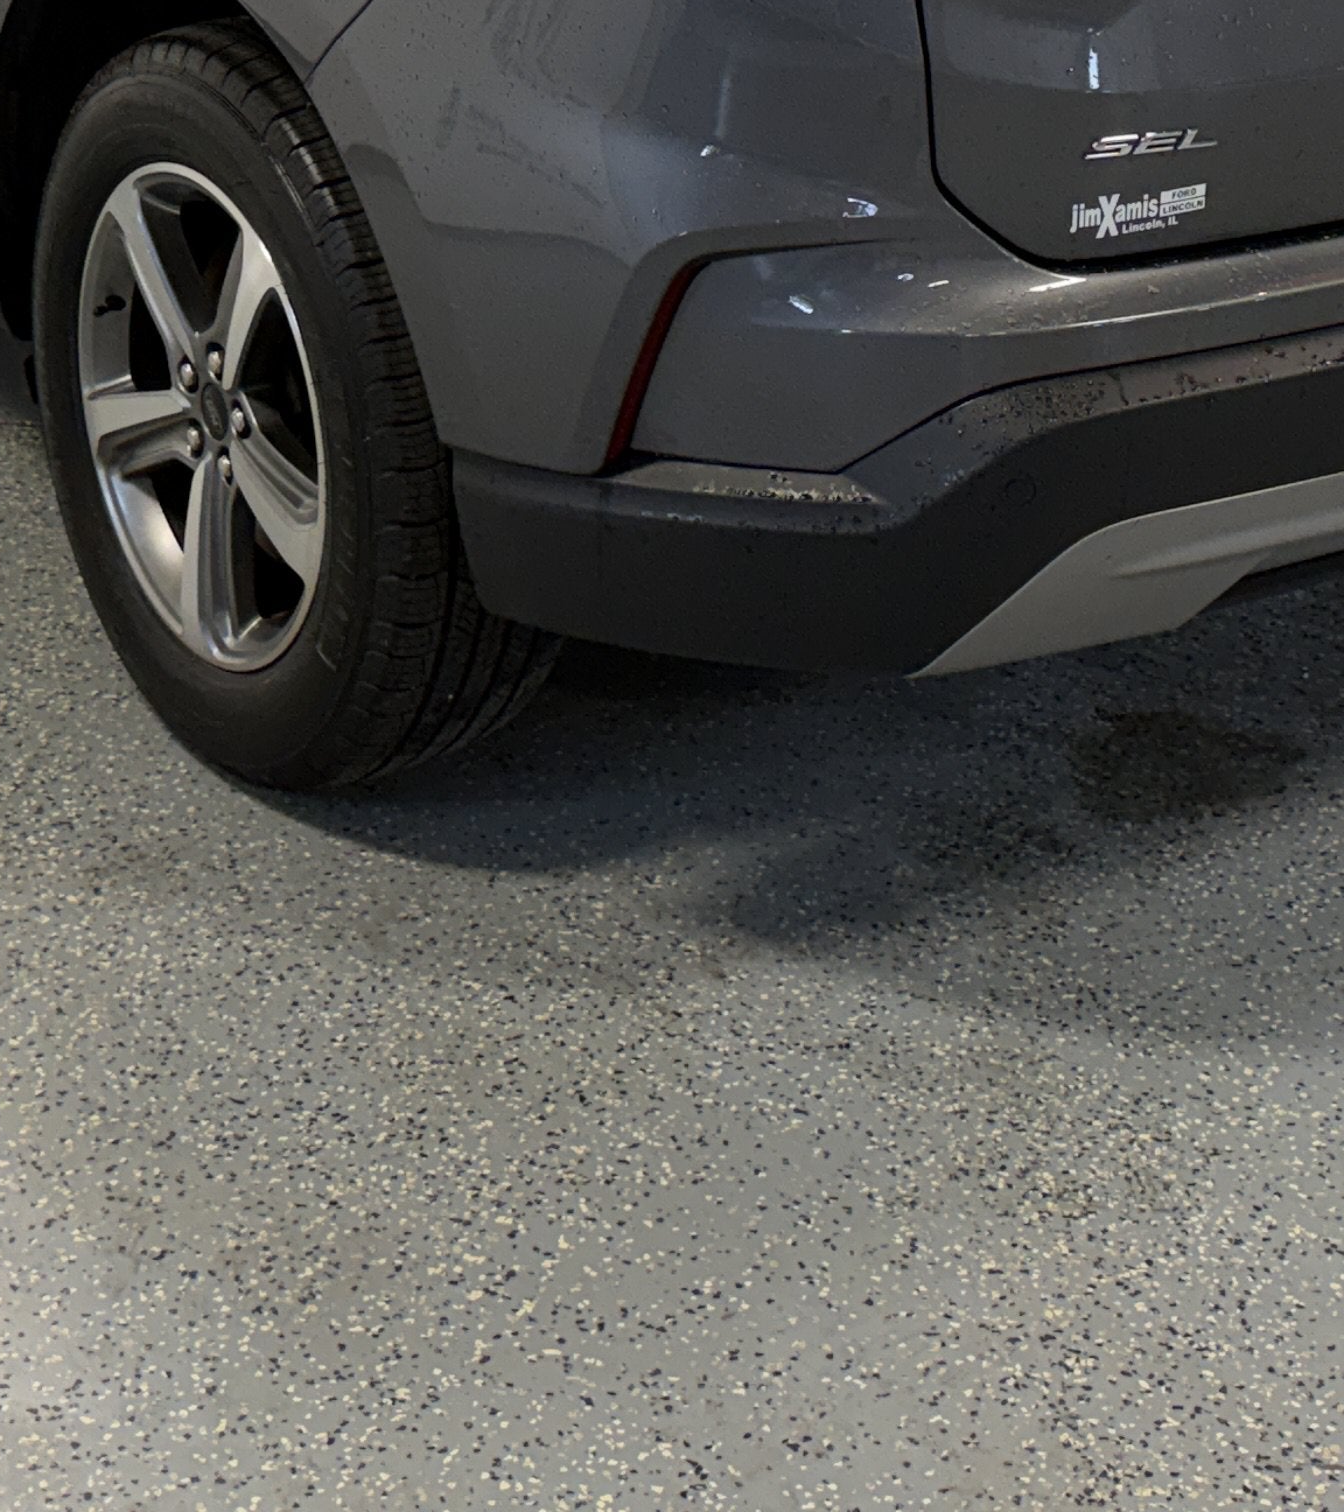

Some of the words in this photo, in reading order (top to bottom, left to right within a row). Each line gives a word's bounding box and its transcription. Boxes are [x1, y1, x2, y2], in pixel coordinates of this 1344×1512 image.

[1084, 128, 1218, 160] SEL
[1171, 187, 1197, 199] FORD
[1162, 200, 1204, 215] LINCOLN
[1167, 216, 1179, 226] IL
